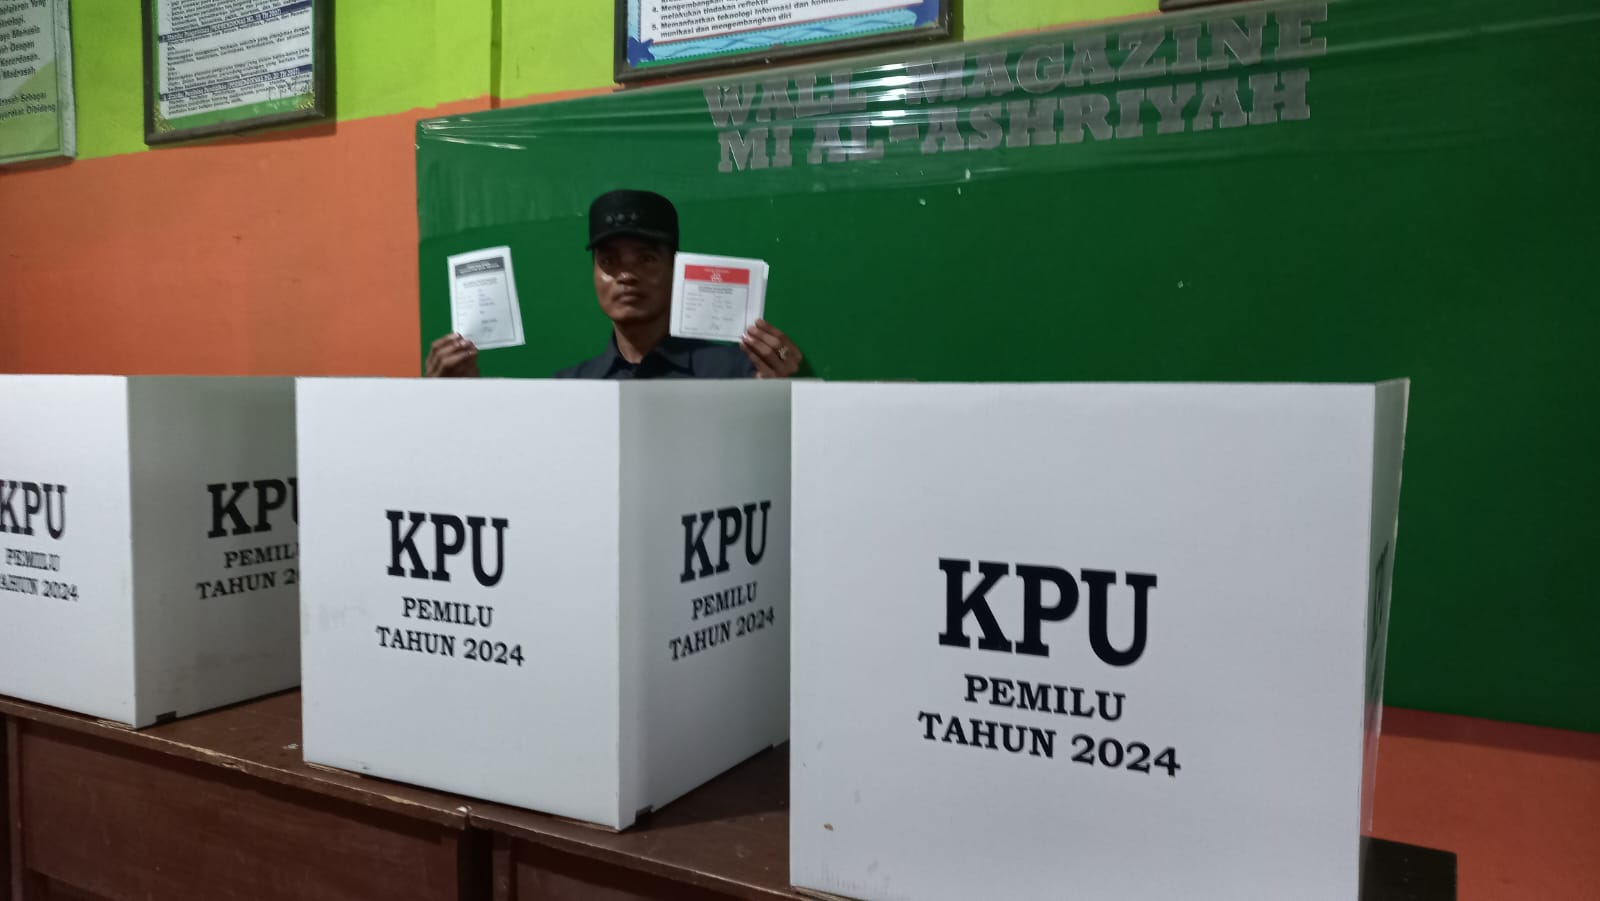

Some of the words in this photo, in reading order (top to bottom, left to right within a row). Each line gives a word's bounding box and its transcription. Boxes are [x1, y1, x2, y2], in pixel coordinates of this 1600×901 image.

[660, 15, 716, 30] Memanfaatkan
[717, 9, 753, 22] teknologi
[754, 3, 792, 15] informasi
[793, 0, 810, 11] dan
[661, 9, 702, 21] melakukan
[703, 4, 736, 15] tindakan
[695, 23, 710, 32] dan
[711, 15, 777, 31] mengembangkan
[703, 72, 867, 128] WALL
[904, 2, 1328, 105] MAGAZINE
[718, 126, 793, 173] MI
[0, 479, 67, 540] KPU
[223, 542, 299, 568] PEMIL
[386, 509, 509, 587] KPU
[680, 500, 771, 583] KPU
[0, 573, 39, 596] AHUN
[42, 580, 79, 601] 2024
[196, 571, 276, 600] TAHUN
[690, 581, 758, 621] PEMILU
[401, 596, 494, 628] PEMILU
[668, 622, 733, 661] TAHUN
[736, 606, 776, 638] 2024
[938, 557, 1158, 667] KPU
[376, 625, 455, 658] TAHUN
[462, 637, 525, 668] 2024
[964, 674, 1126, 722] PEMILU
[918, 711, 1056, 759] TAHUN
[1070, 734, 1182, 777] 2024
